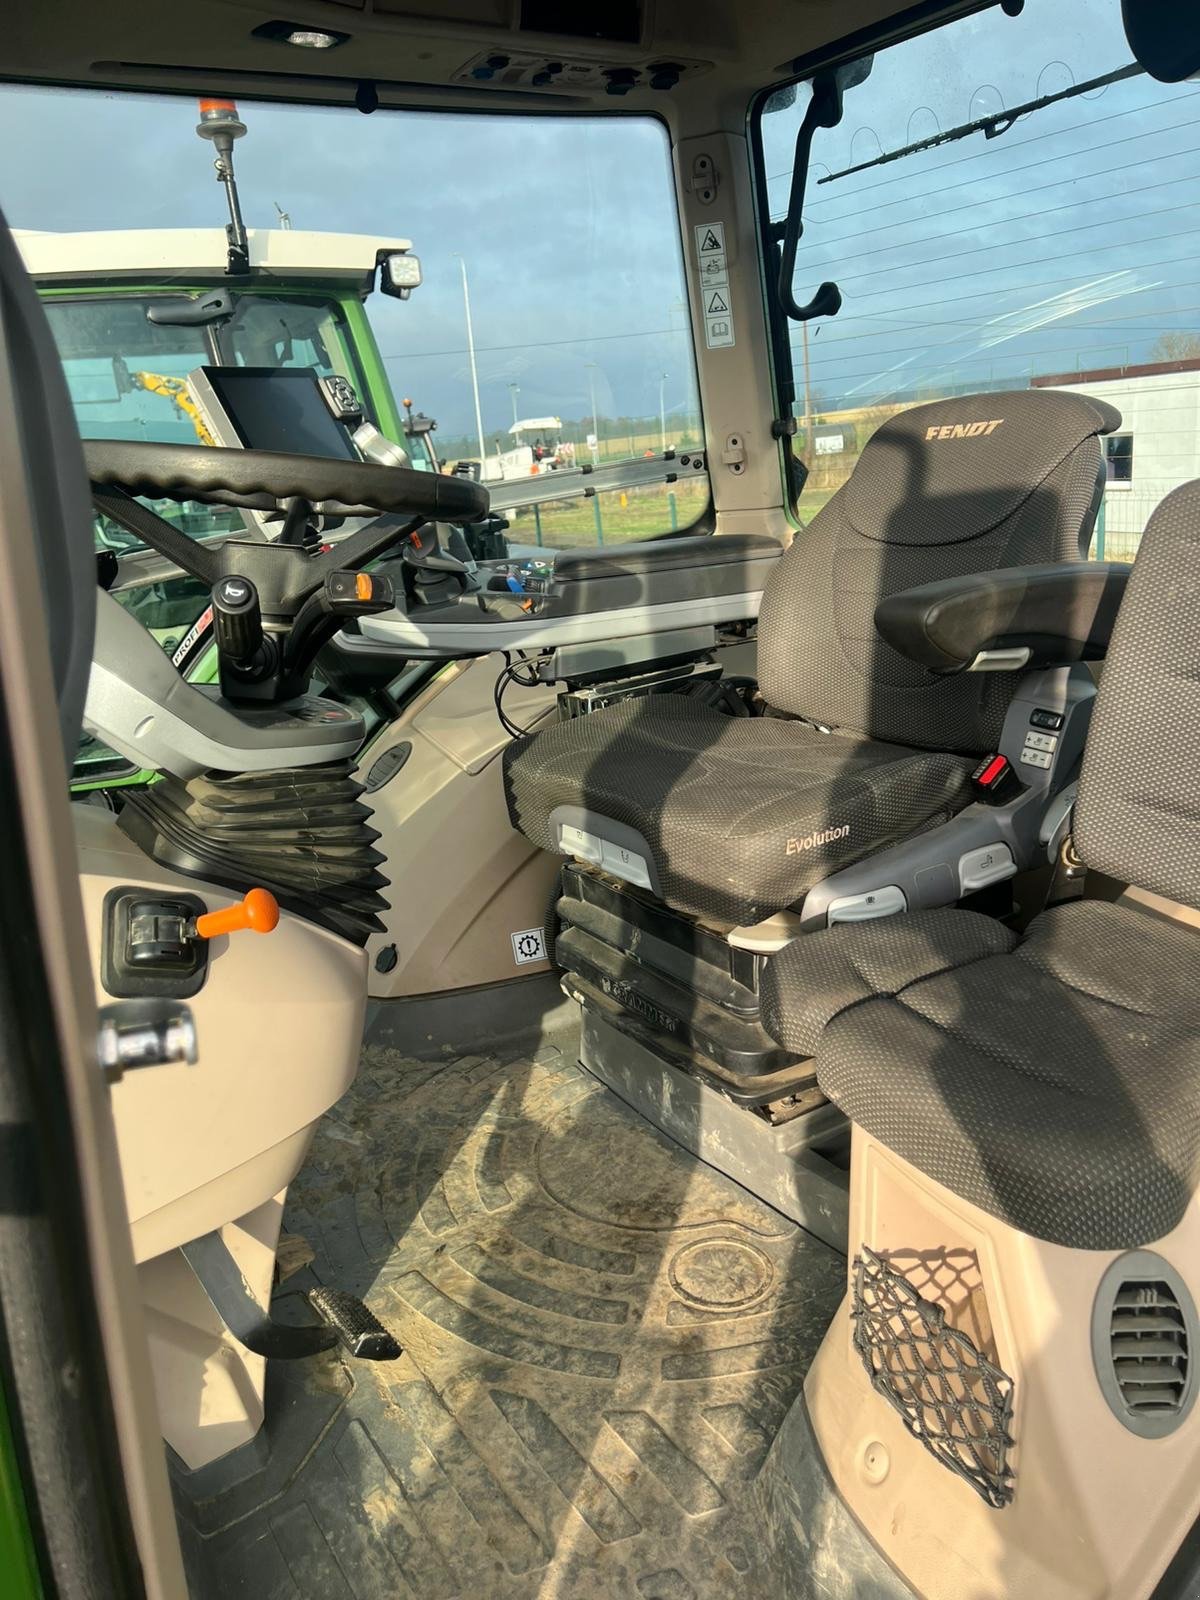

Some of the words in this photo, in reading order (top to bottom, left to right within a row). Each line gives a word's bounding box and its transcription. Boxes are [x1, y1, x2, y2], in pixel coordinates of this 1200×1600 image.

[925, 419, 1004, 440] FENDT
[174, 627, 200, 664] PROFI
[785, 824, 850, 856] Evolution
